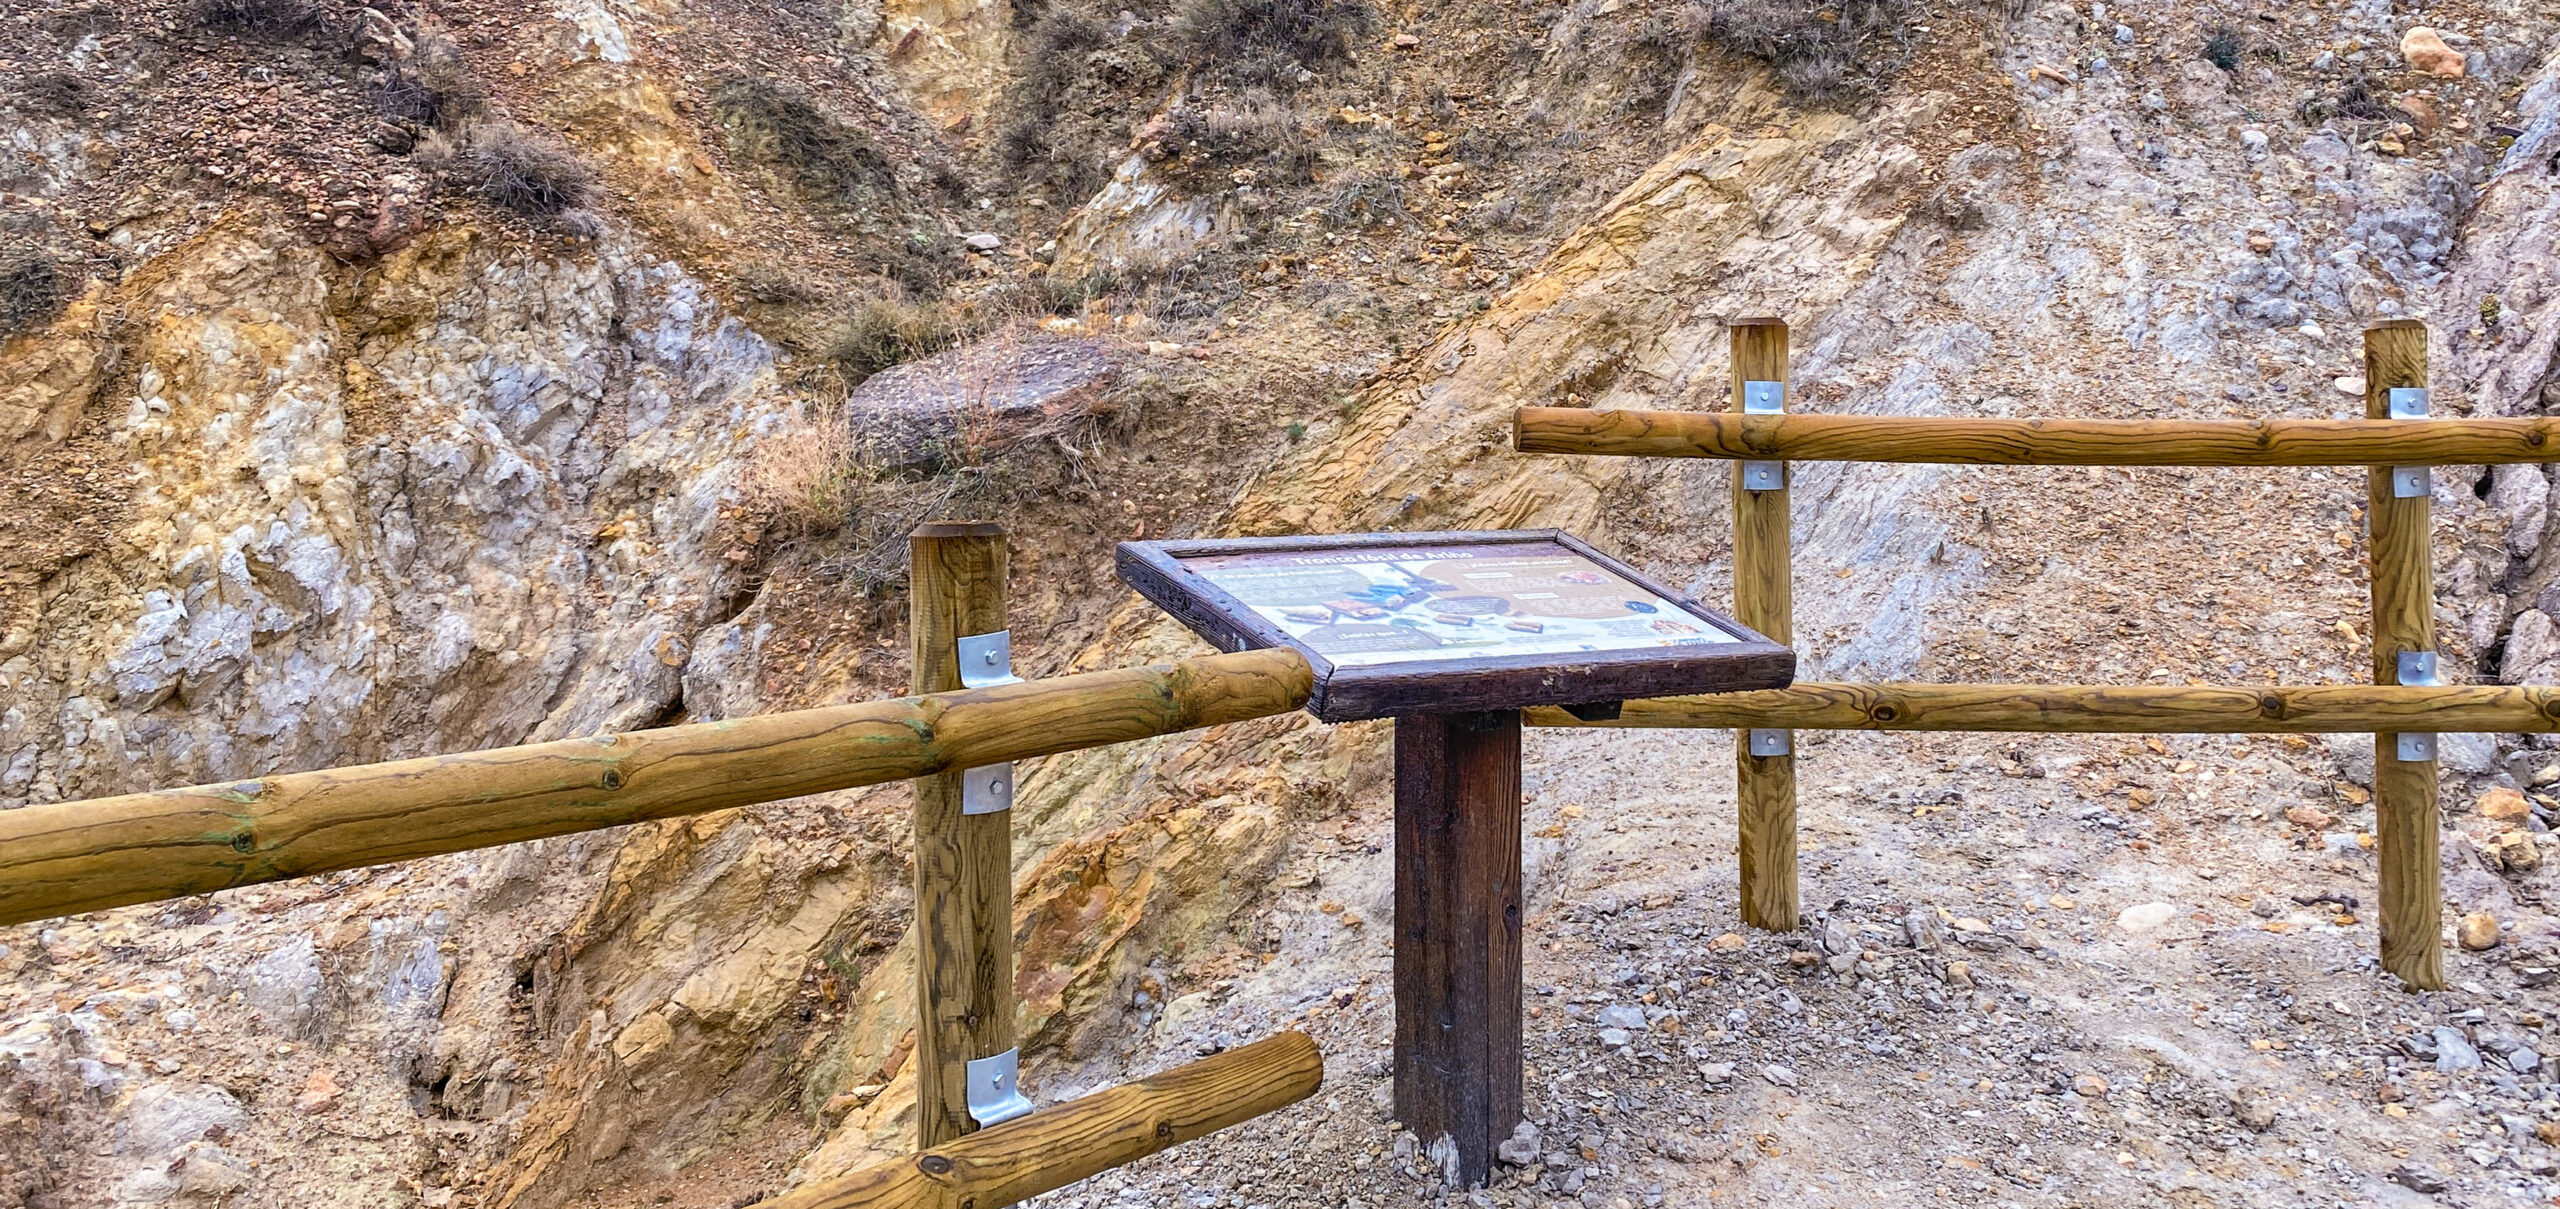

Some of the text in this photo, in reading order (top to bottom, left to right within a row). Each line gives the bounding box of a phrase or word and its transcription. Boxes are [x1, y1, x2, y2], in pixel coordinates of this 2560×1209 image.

[1290, 556, 1357, 565] Tronco
[1357, 553, 1400, 562] fósil
[1400, 552, 1425, 560] de
